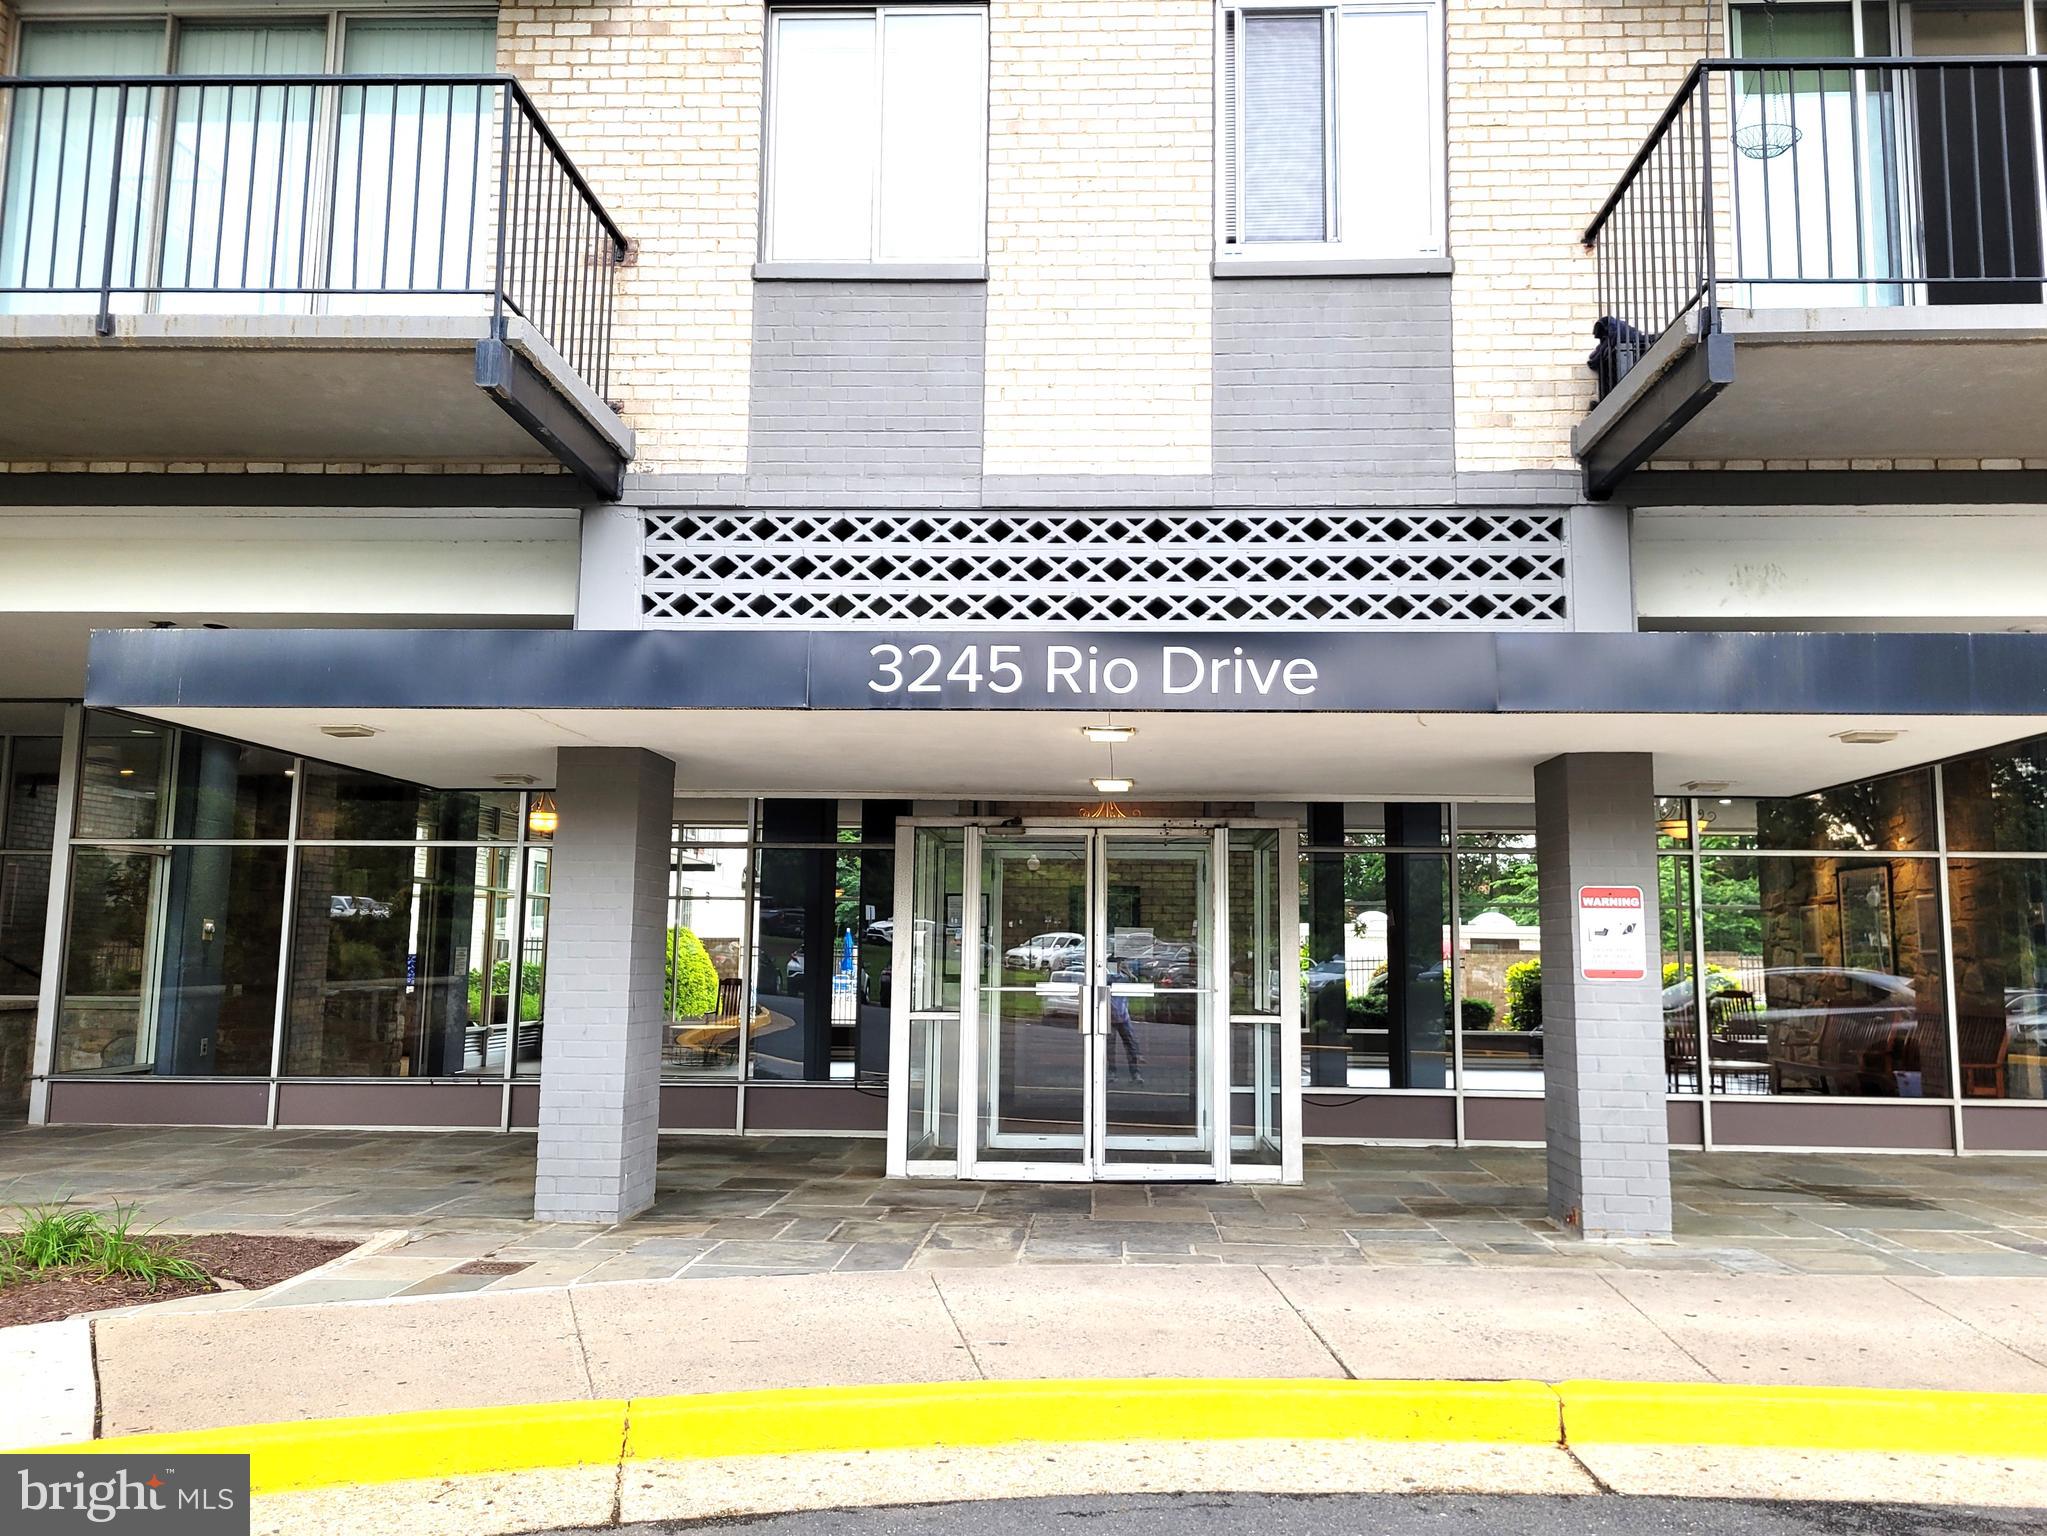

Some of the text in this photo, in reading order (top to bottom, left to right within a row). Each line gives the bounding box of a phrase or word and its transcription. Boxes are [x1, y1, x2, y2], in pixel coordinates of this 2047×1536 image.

[867, 643, 1318, 695] 3245 Rio Drive
[1582, 897, 1639, 907] WARNING
